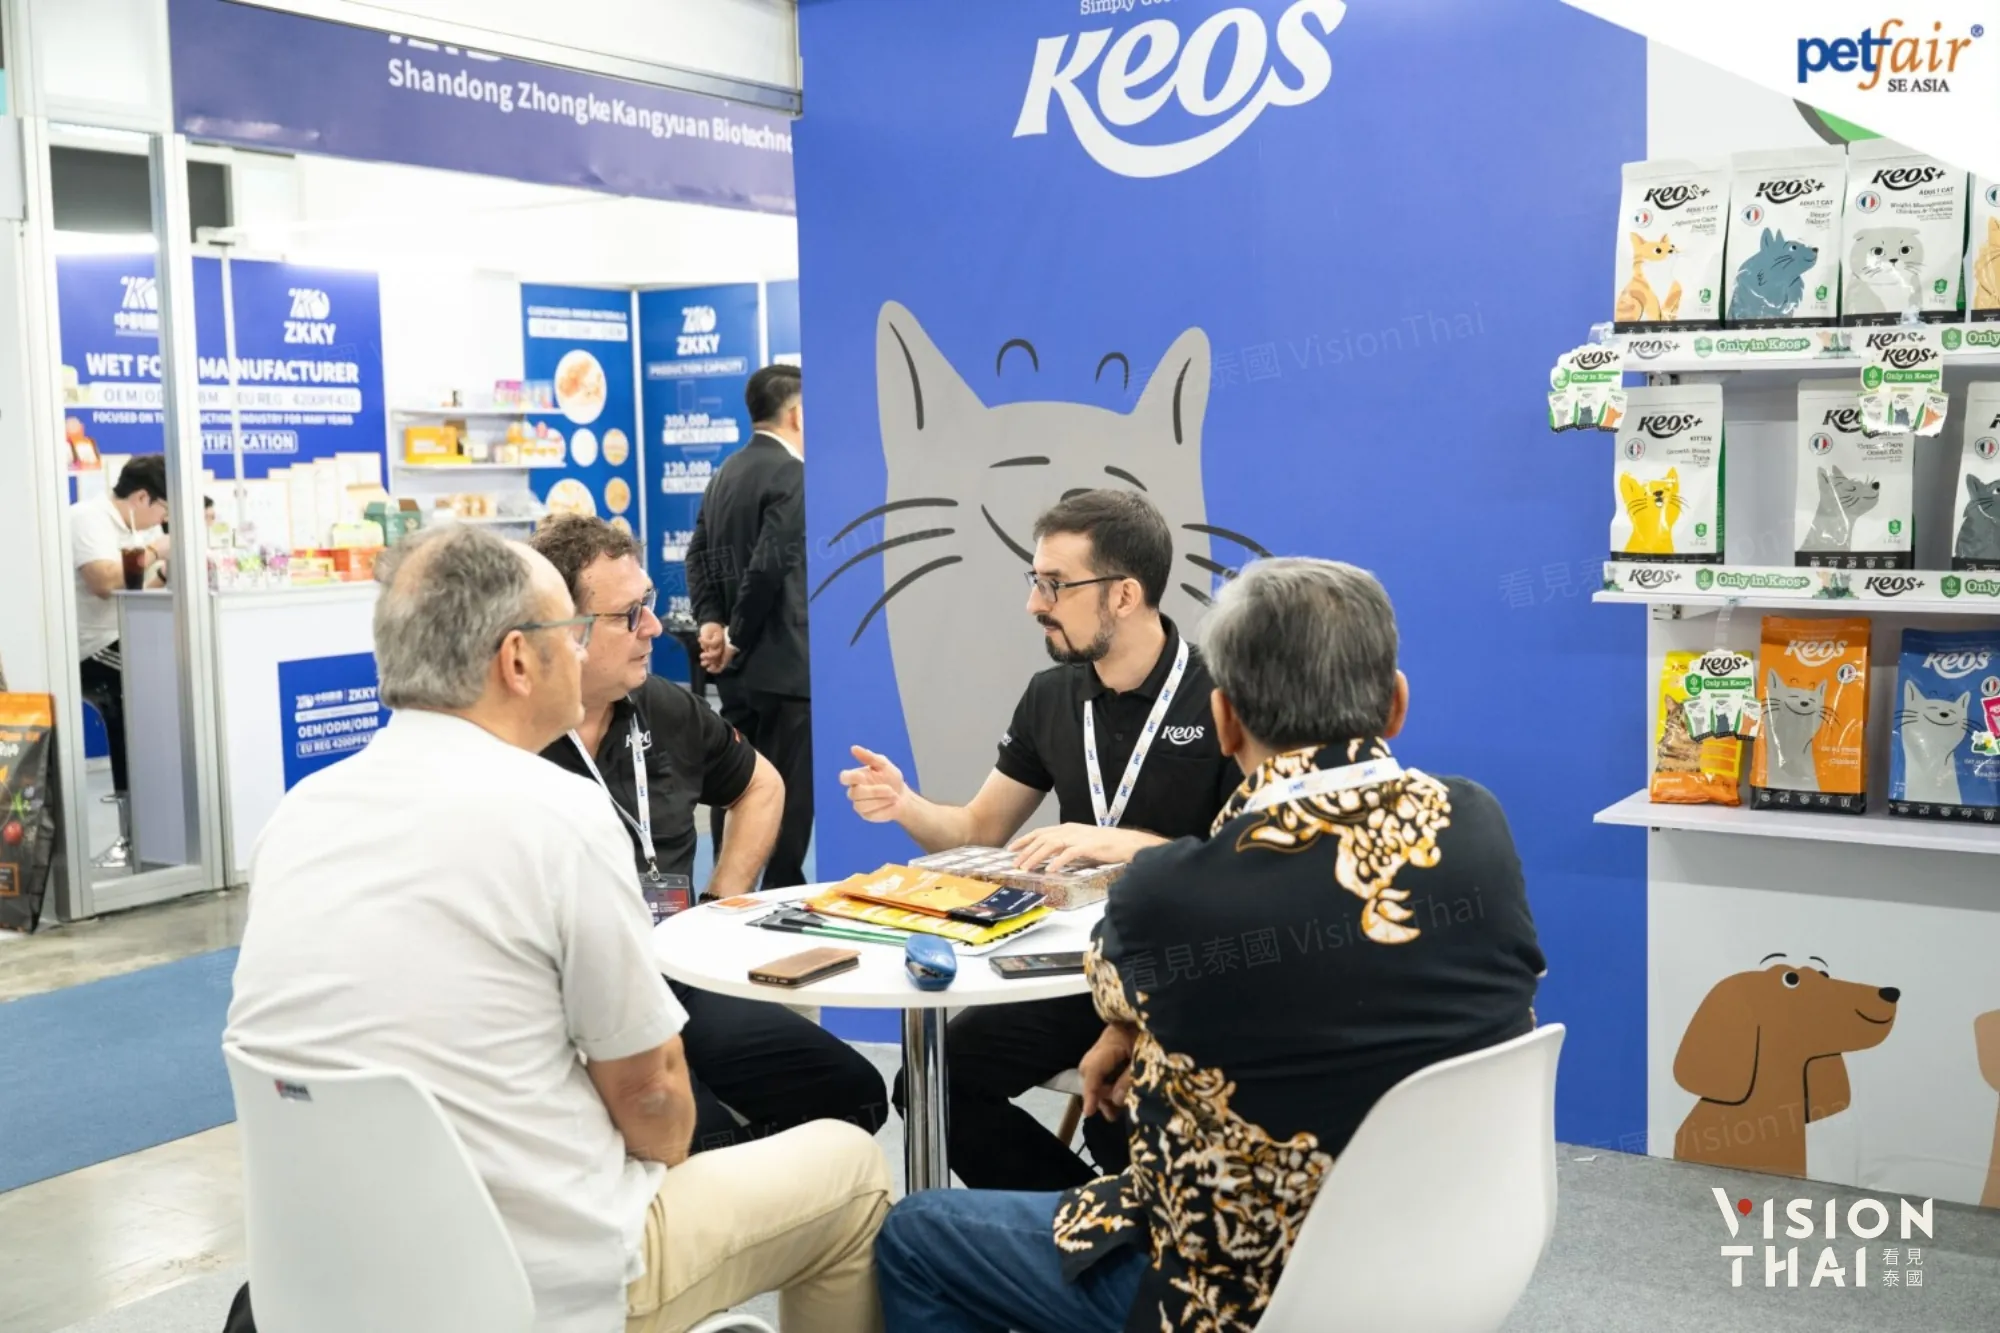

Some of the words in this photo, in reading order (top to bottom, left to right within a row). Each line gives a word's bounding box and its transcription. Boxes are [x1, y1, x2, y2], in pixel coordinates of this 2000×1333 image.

[388, 59, 513, 113] Shandong
[517, 82, 611, 125] Zhongke
[613, 99, 709, 139] Kangyuan
[283, 320, 336, 345] ZKKY
[676, 334, 720, 356] ZKKY
[1716, 339, 1749, 352] Only
[86, 353, 133, 377] WET
[137, 354, 160, 378] FO
[199, 357, 359, 384] MANUFACTURER
